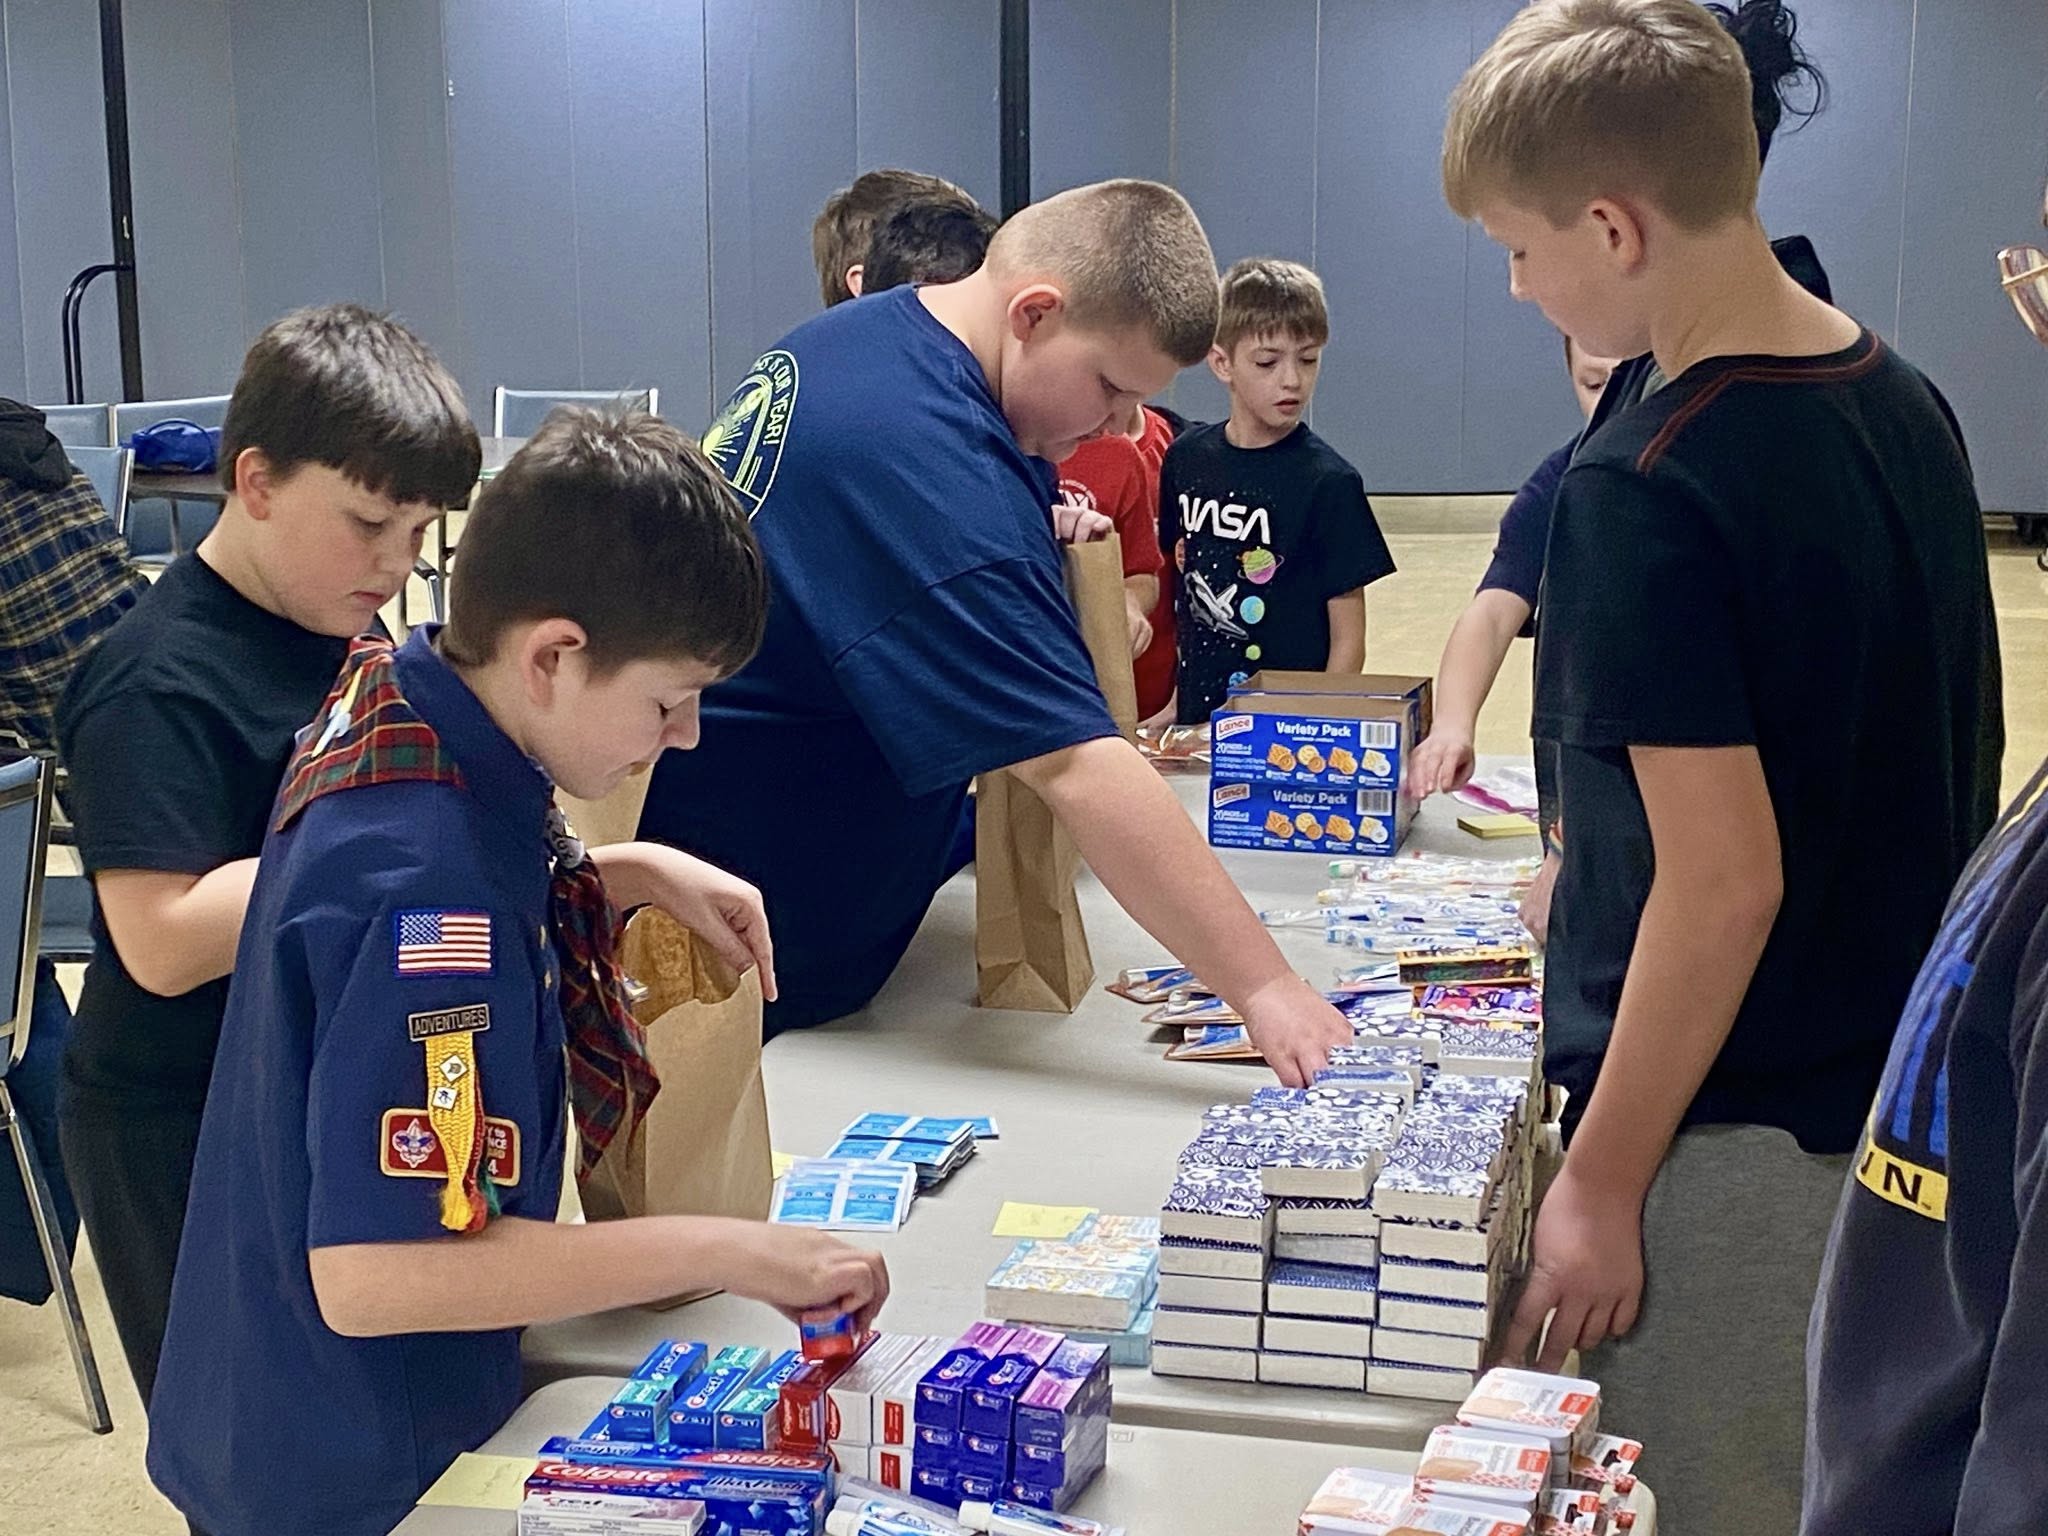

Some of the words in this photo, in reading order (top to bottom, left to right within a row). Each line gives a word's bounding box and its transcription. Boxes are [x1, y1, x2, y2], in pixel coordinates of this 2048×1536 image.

[773, 365, 791, 394] OUR
[763, 392, 790, 446] YEAR!
[1179, 494, 1271, 545] NASA
[1219, 719, 1250, 733] Lance
[1276, 721, 1319, 736] Variety
[1321, 724, 1352, 737] Pack
[1216, 786, 1247, 800] Lance
[1273, 789, 1315, 804] Variety
[1318, 792, 1348, 804] Pack
[414, 1009, 486, 1036] ADVENTURES
[712, 1453, 817, 1468] Colgate
[542, 1464, 668, 1482] Colgate
